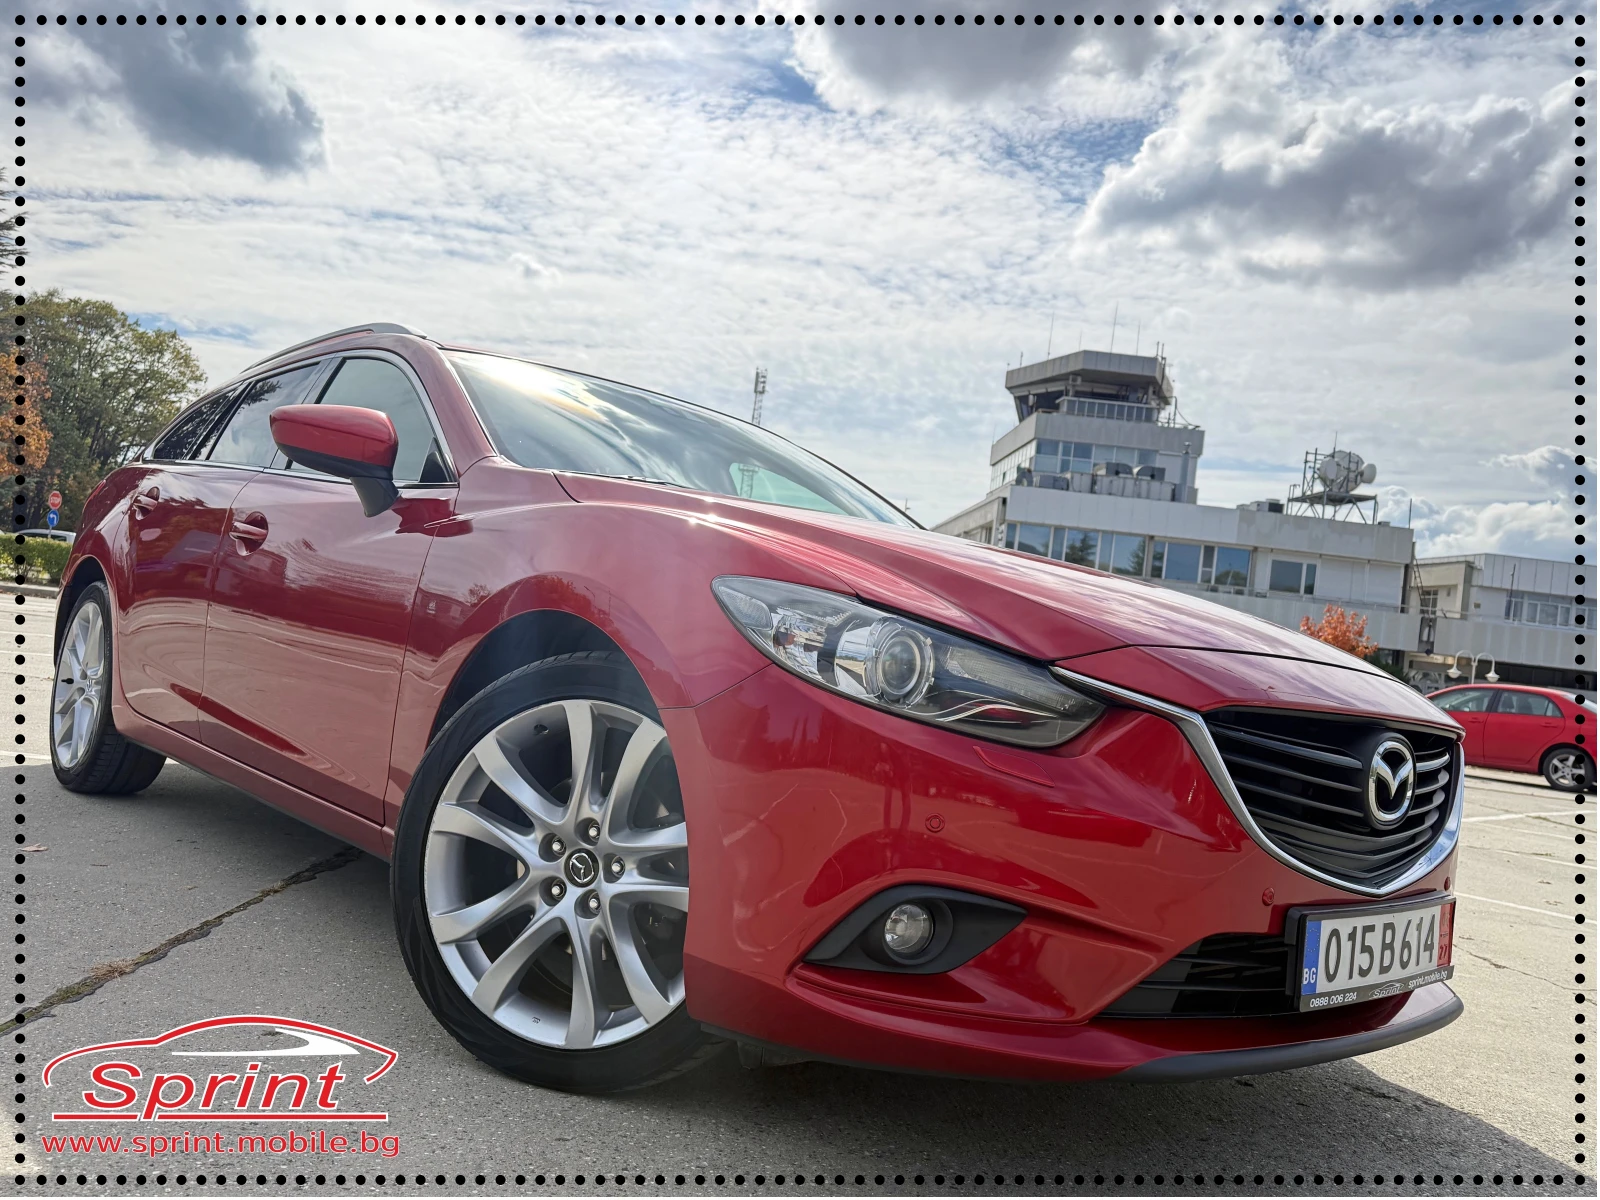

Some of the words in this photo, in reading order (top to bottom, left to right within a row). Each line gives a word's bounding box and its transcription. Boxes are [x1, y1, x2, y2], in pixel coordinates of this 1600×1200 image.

[1324, 913, 1436, 983] 015B614
[1303, 967, 1317, 985] BG
[1408, 970, 1448, 989] sprint.mobile.bg
[1310, 996, 1329, 1008] 0888
[1330, 993, 1344, 1005] 006
[1344, 991, 1358, 1002] 224
[1372, 986, 1401, 998] Sprint
